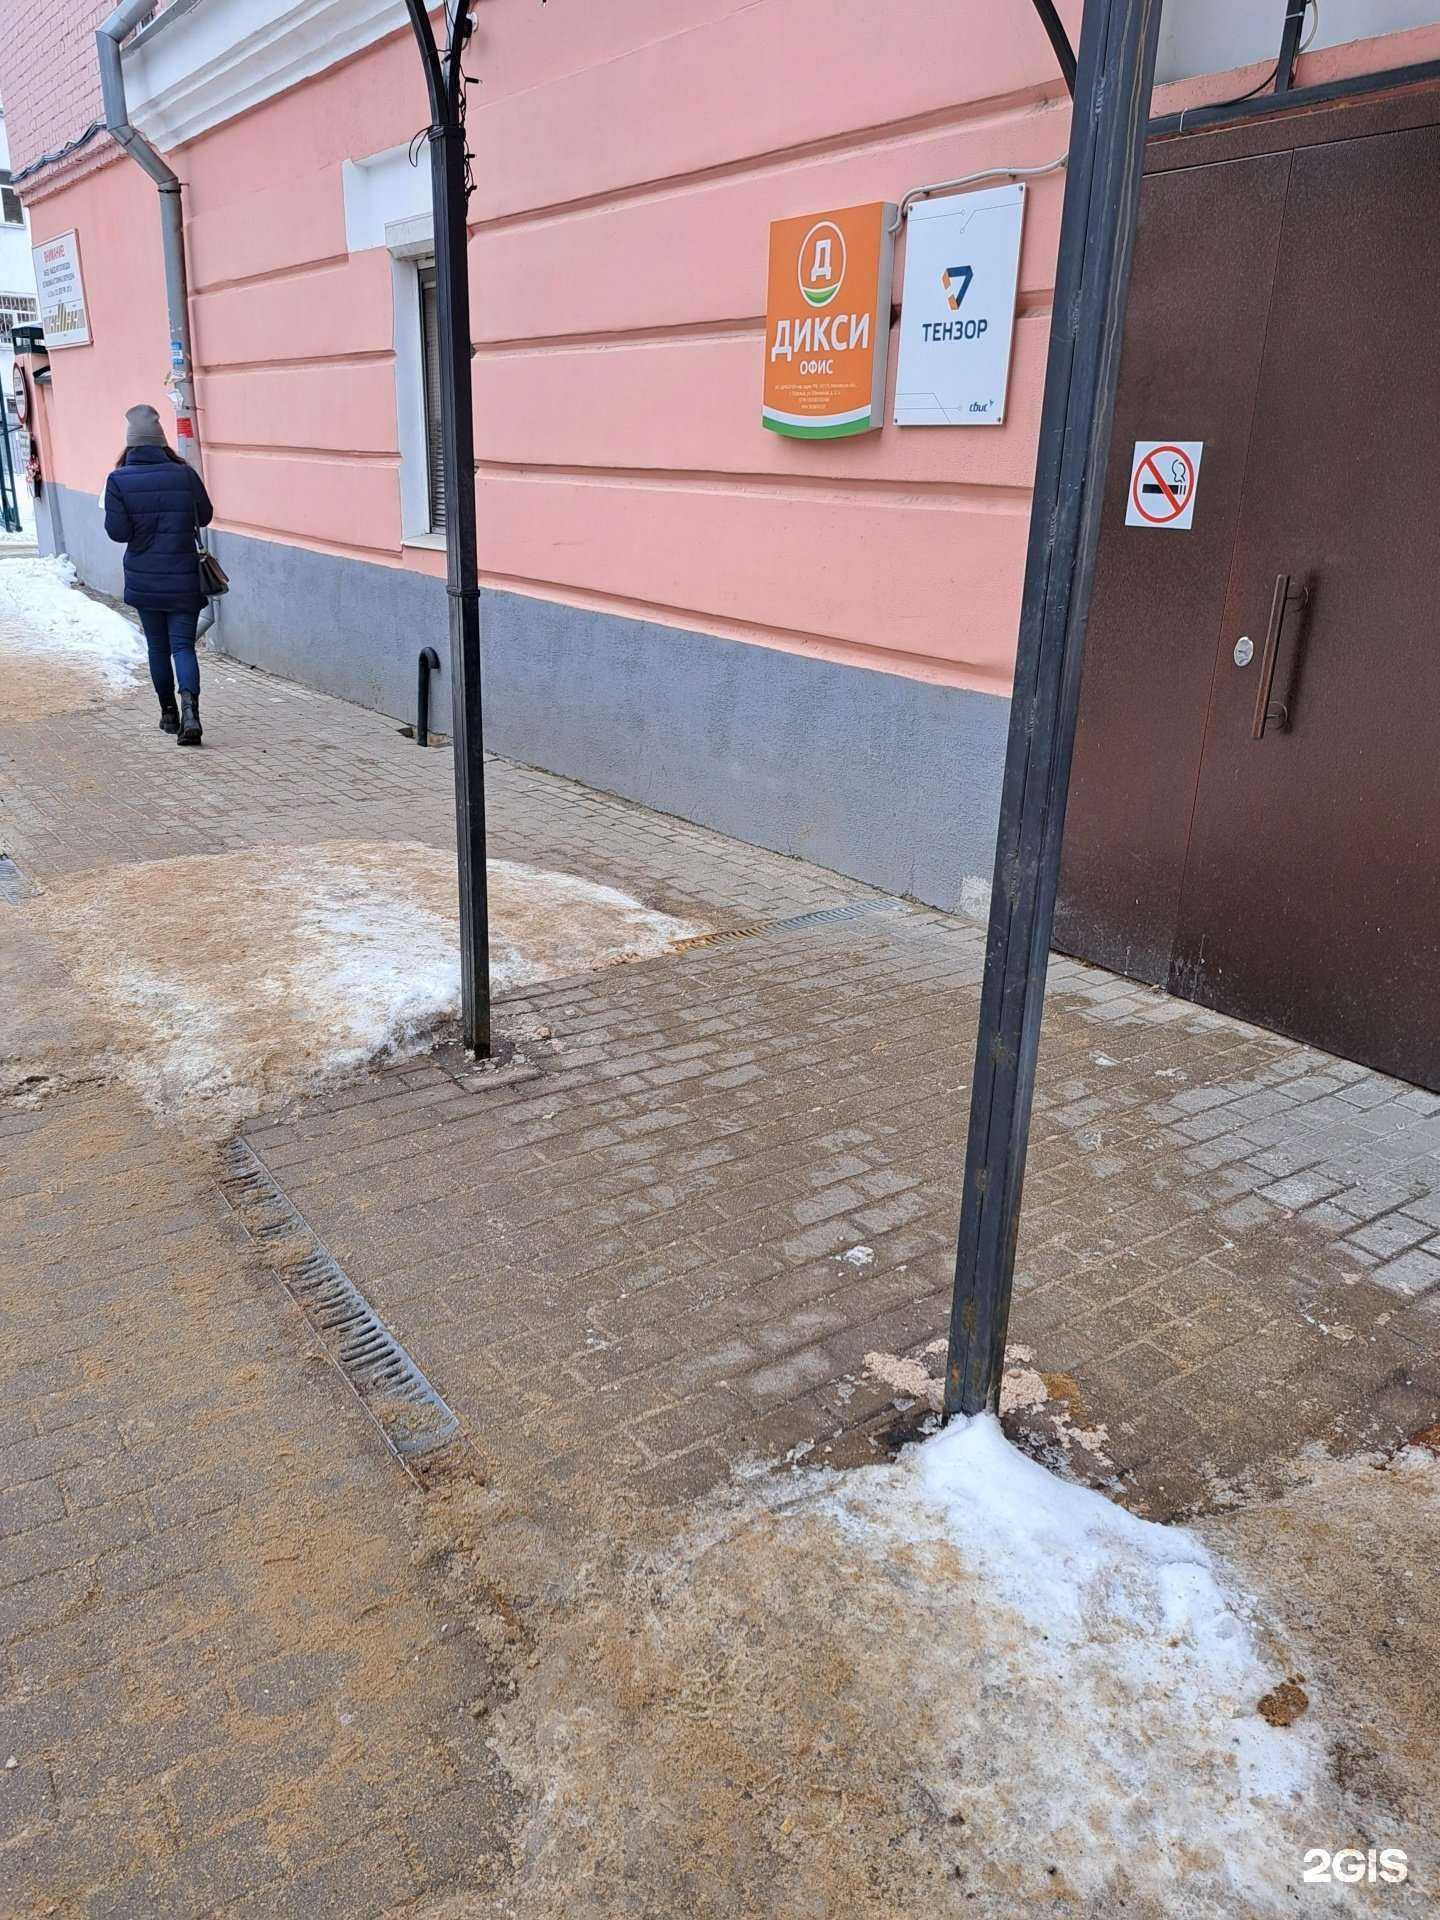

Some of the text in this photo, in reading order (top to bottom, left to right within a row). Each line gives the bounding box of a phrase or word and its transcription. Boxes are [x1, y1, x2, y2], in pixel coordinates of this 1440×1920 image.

[811, 239, 832, 281] Д
[771, 313, 870, 362] ДИКСИ
[922, 319, 988, 342] ТЕНЗОР
[799, 360, 834, 375] ОФИС
